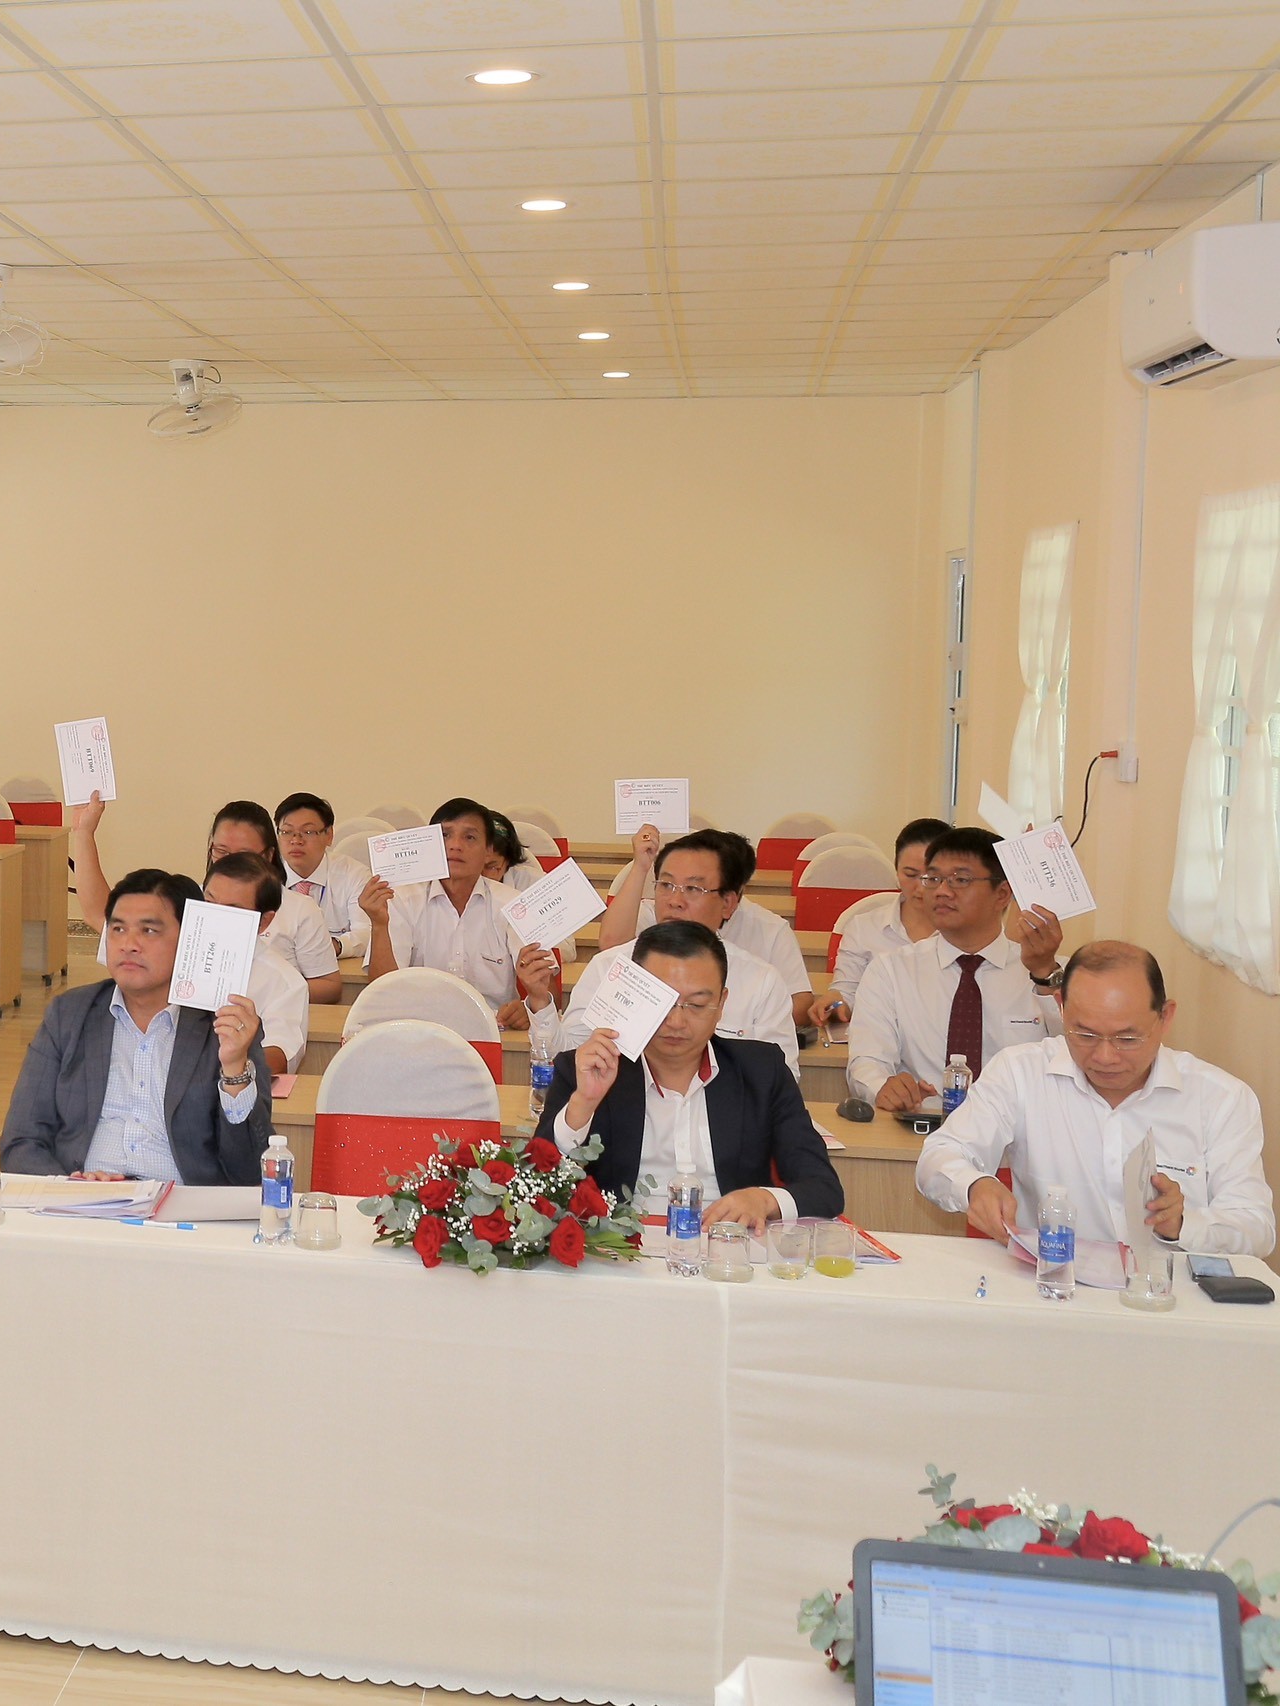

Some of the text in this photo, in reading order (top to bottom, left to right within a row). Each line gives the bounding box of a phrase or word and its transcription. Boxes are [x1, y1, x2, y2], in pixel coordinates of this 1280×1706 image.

[1040, 860, 1057, 888] BTT236
[538, 896, 562, 915] BTT029
[204, 941, 217, 974] BTT266
[614, 991, 634, 1008] BTT007
[1040, 1239, 1066, 1250] AQUAFINA
